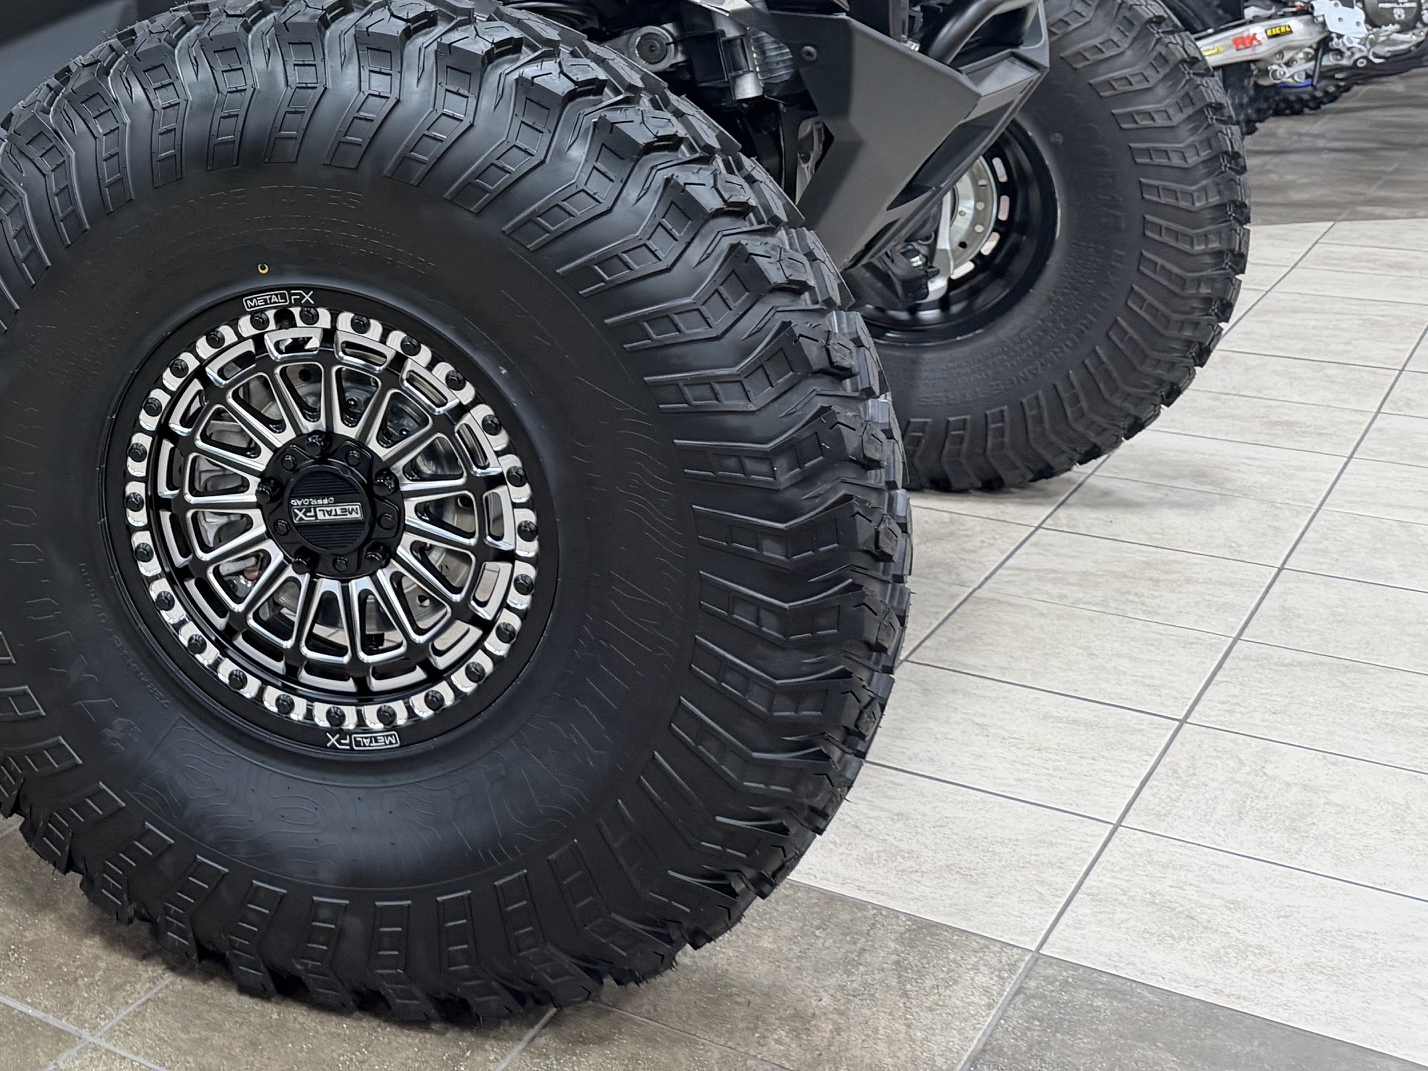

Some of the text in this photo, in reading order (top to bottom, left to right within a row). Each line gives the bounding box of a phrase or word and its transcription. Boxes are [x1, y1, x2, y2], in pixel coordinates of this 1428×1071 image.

[245, 289, 315, 310] METAL FX
[290, 497, 335, 506] OFFROAD
[293, 506, 360, 521] METAL FX
[326, 732, 398, 749] METAL FX
